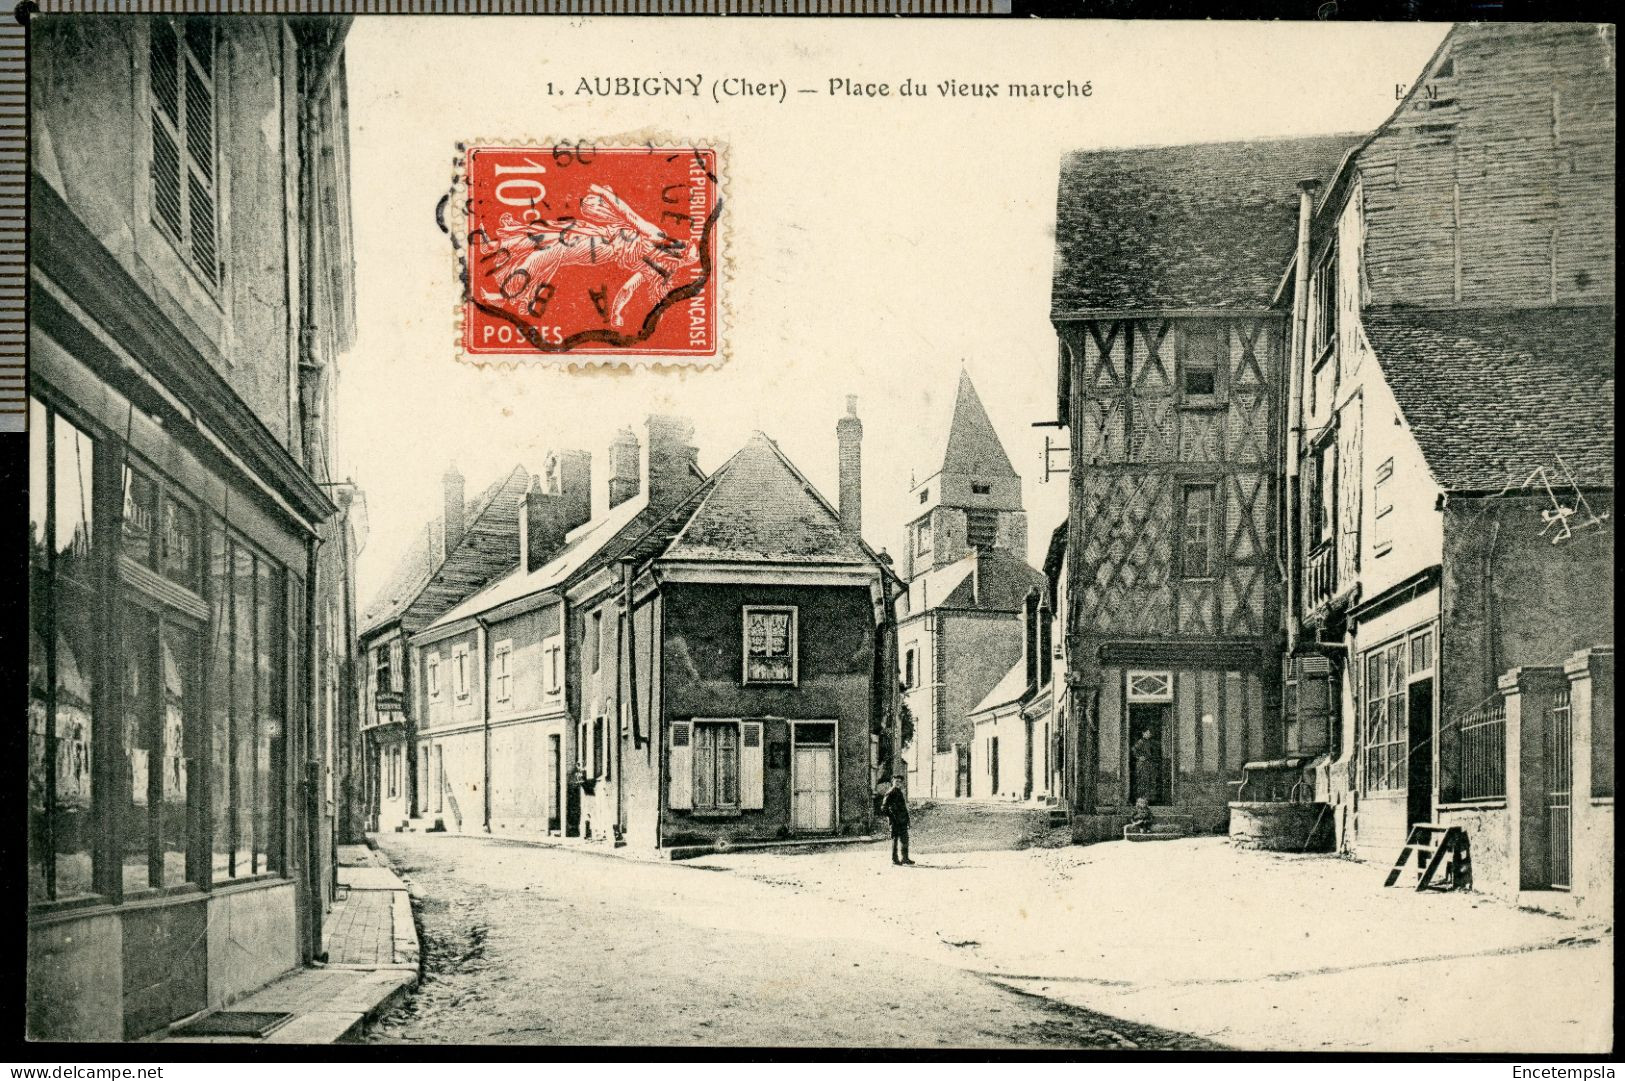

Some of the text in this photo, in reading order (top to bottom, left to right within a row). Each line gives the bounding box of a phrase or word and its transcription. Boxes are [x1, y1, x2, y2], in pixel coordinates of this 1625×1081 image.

[575, 73, 703, 97] AUBIGNY
[712, 79, 788, 103] (Cher)
[899, 78, 928, 97] du
[937, 80, 999, 98] vieux
[689, 267, 706, 346] FNÇAISE
